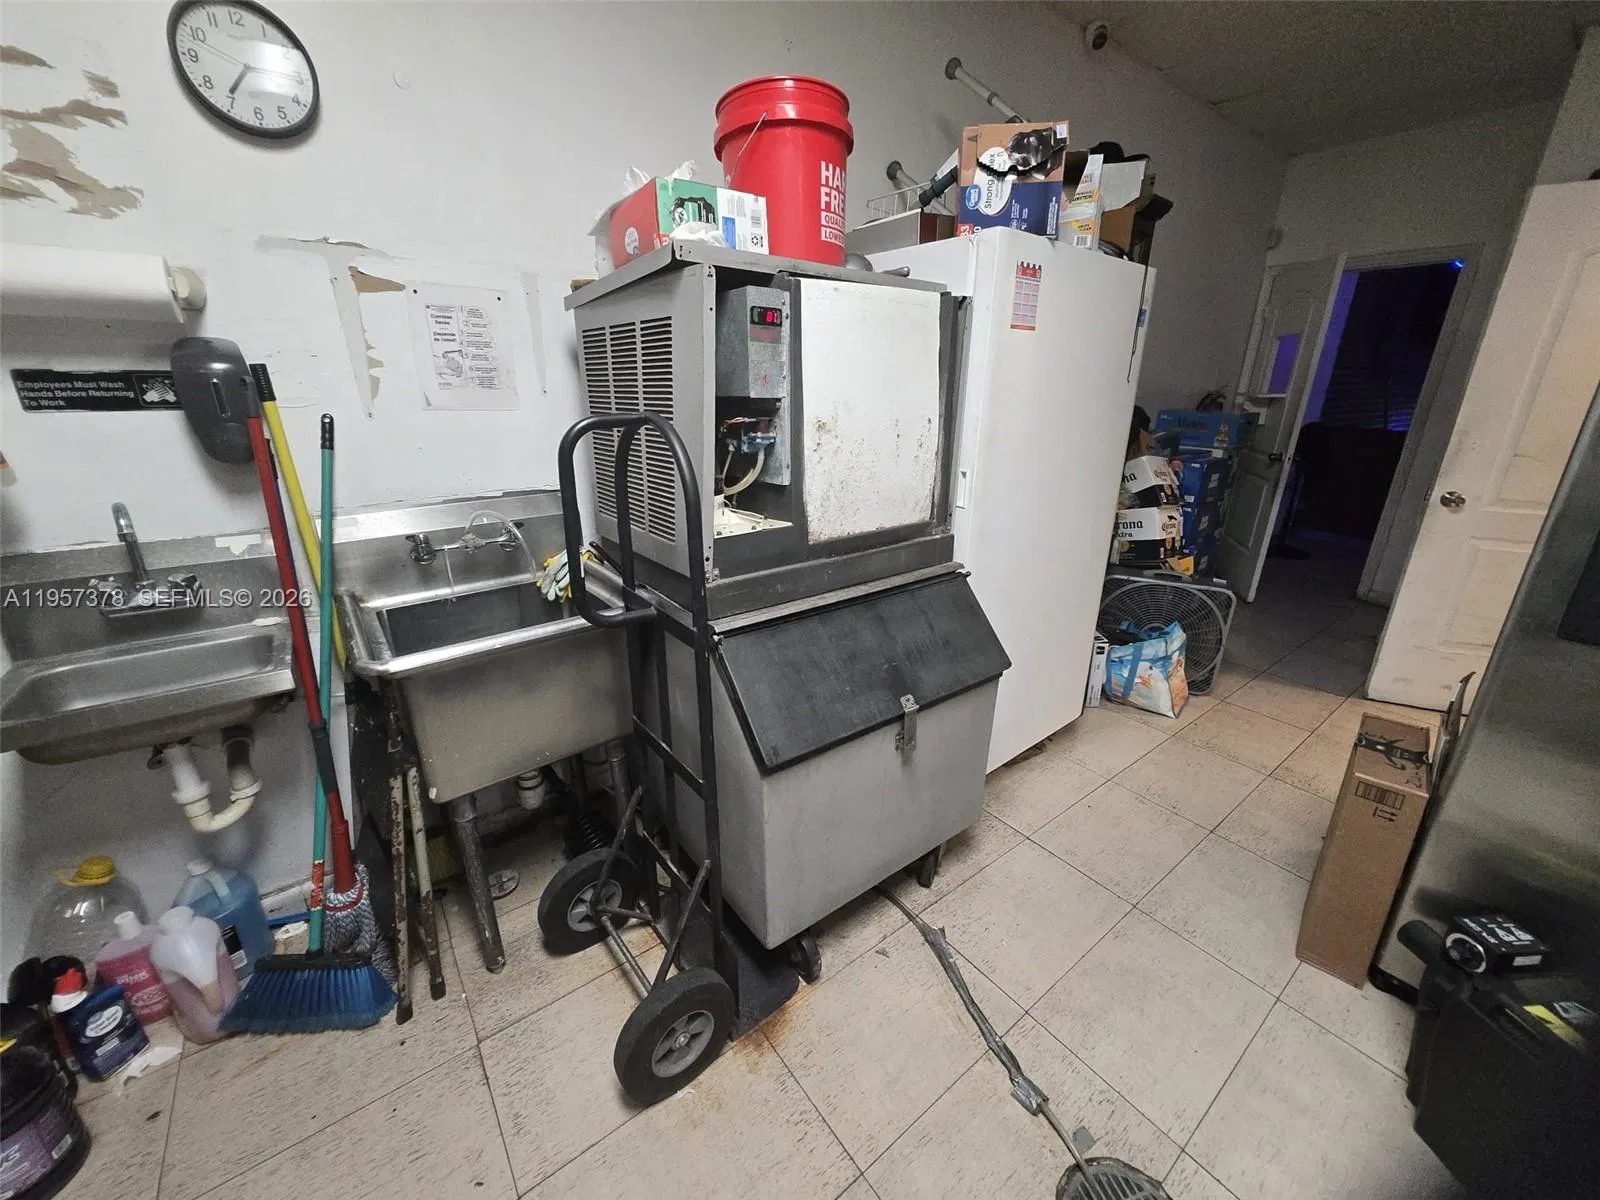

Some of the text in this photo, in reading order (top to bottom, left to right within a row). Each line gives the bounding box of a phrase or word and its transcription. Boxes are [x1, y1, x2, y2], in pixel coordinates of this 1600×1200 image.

[207, 11, 218, 28] 11
[228, 8, 245, 27] 12
[190, 25, 206, 43] 10
[187, 48, 199, 63] 9
[202, 74, 214, 90] 8
[226, 95, 236, 109] 7
[291, 93, 302, 106] 4
[253, 106, 264, 121] 6
[277, 105, 288, 120] 5
[984, 179, 996, 209] Strong
[17, 380, 125, 390] Employees Must Wash
[20, 390, 135, 399] Hands Before Returning
[25, 399, 67, 407] To Work
